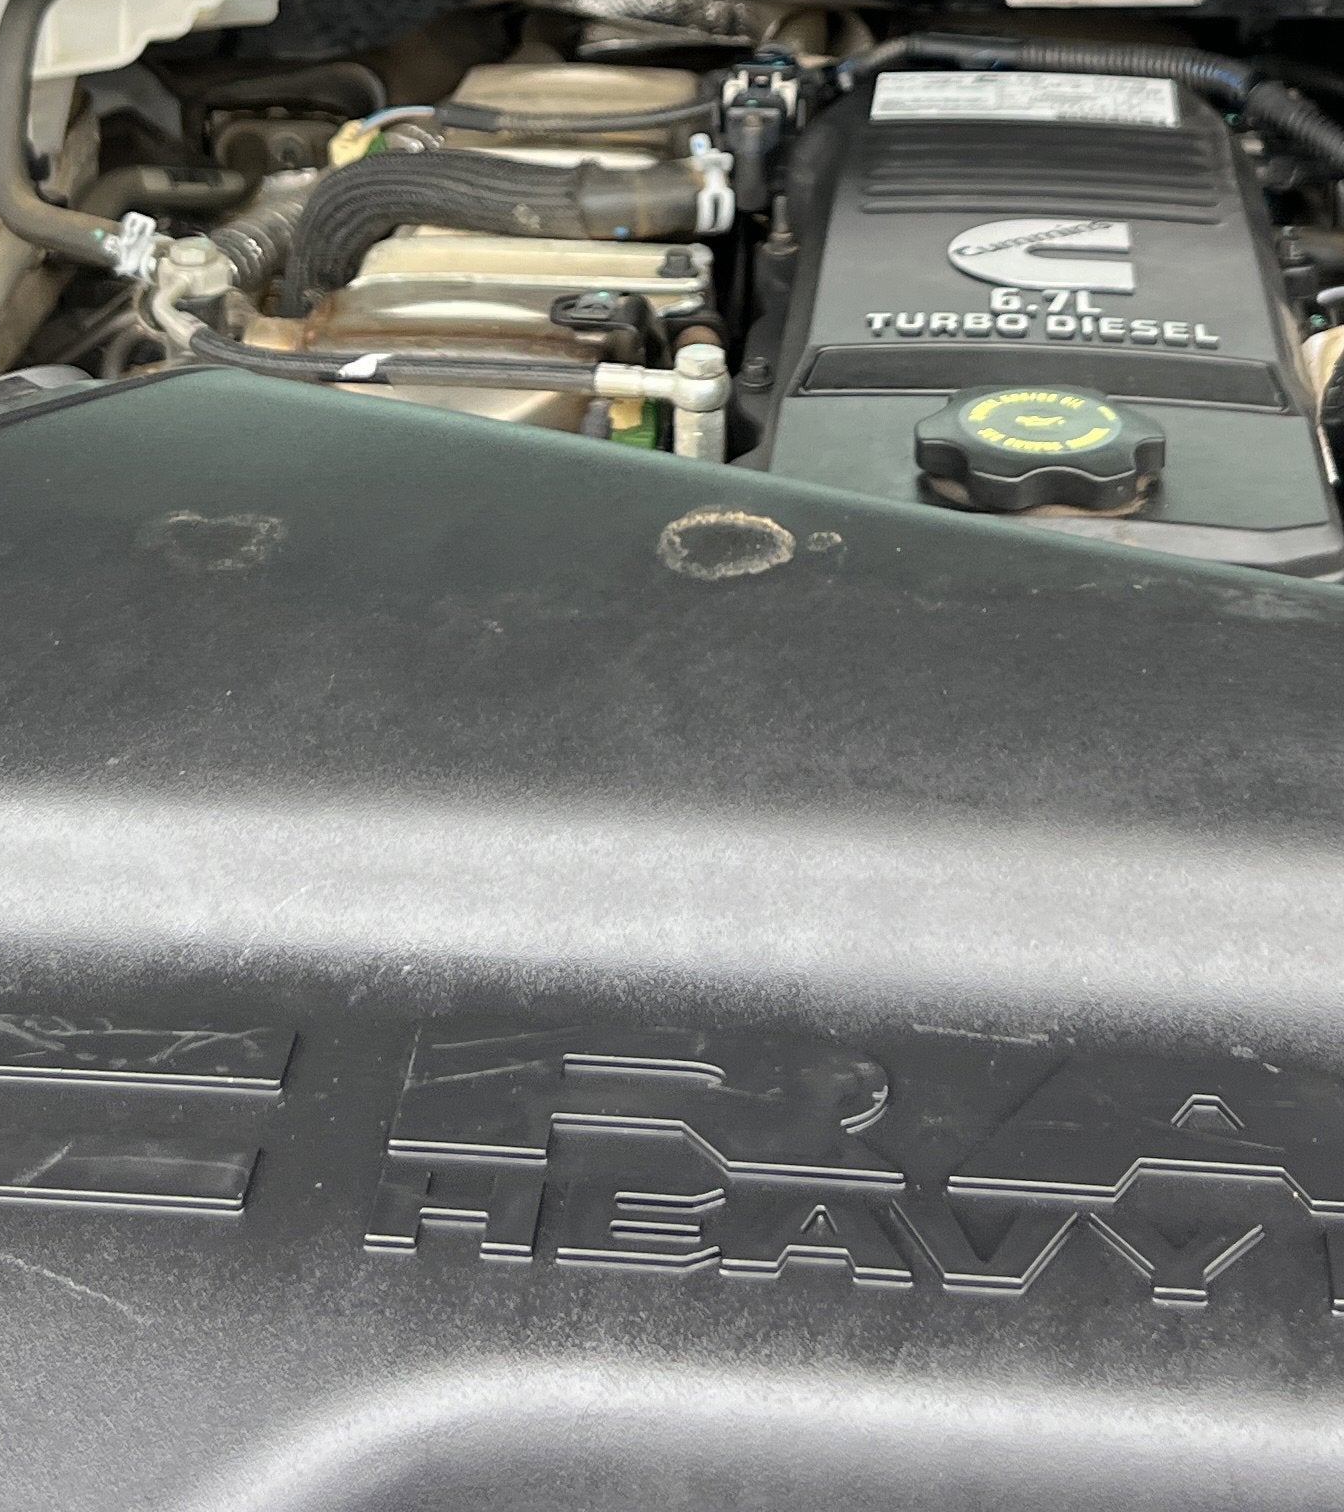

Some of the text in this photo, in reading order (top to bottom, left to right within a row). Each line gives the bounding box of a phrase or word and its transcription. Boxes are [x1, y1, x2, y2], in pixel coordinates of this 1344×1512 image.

[989, 288, 1103, 317] 6.7L
[865, 311, 1221, 350] TURBO DIESEL
[363, 1167, 1266, 1305] HEAVY
